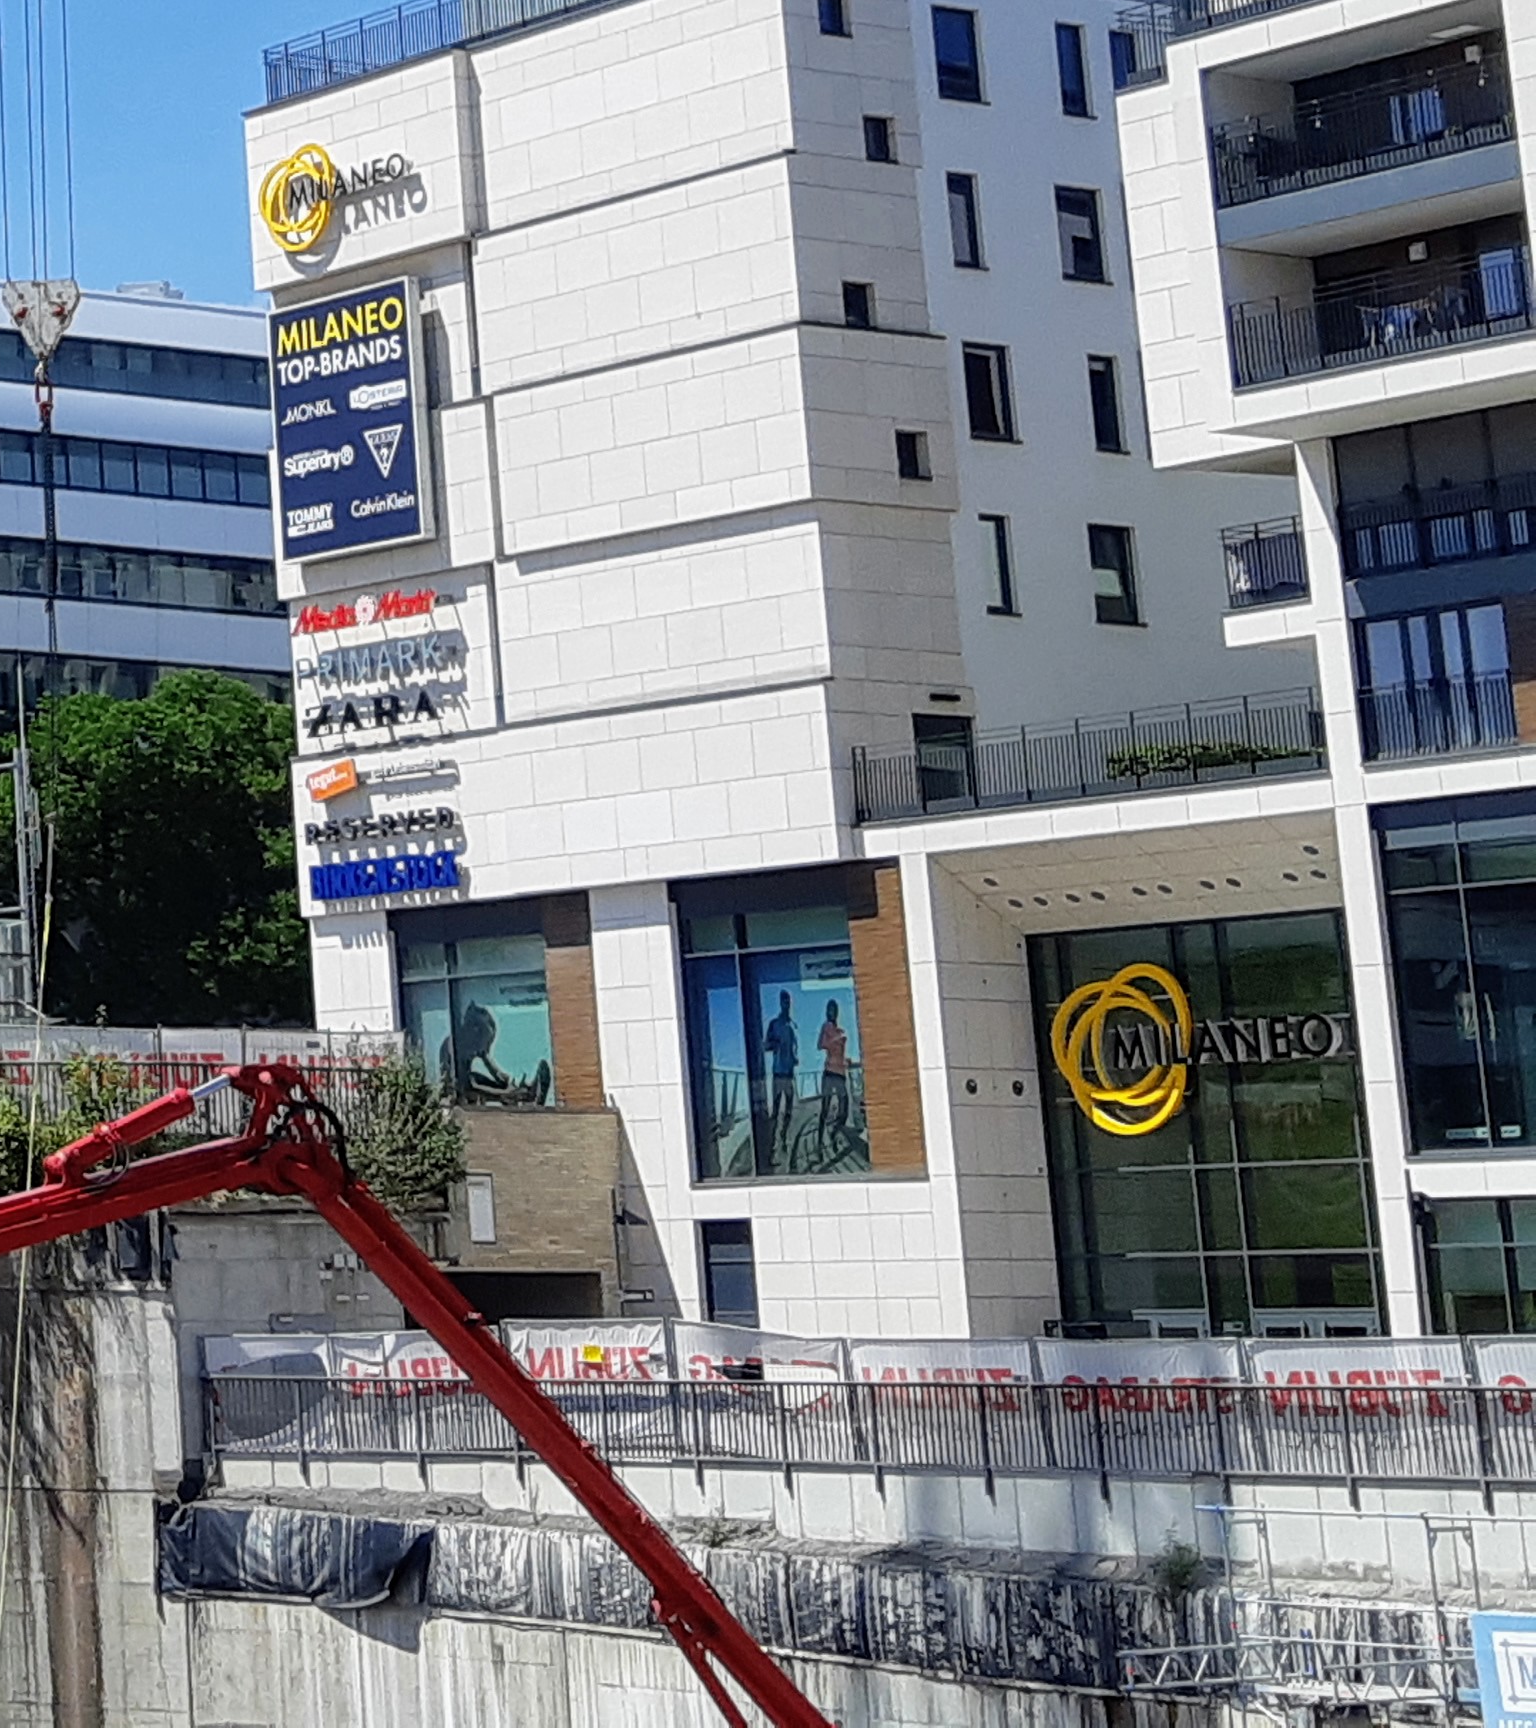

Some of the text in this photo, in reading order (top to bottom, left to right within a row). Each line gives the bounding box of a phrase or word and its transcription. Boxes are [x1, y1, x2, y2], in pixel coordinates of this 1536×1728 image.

[289, 153, 405, 210] MILANEO
[277, 297, 403, 357] MILANEO
[277, 335, 402, 386] TOP-BRANDS
[287, 502, 333, 526] TOMMY
[296, 634, 443, 690] PRIMARK
[305, 691, 443, 738] ZARA
[305, 806, 455, 846] RESERVED
[1114, 1013, 1334, 1069] MILANEO
